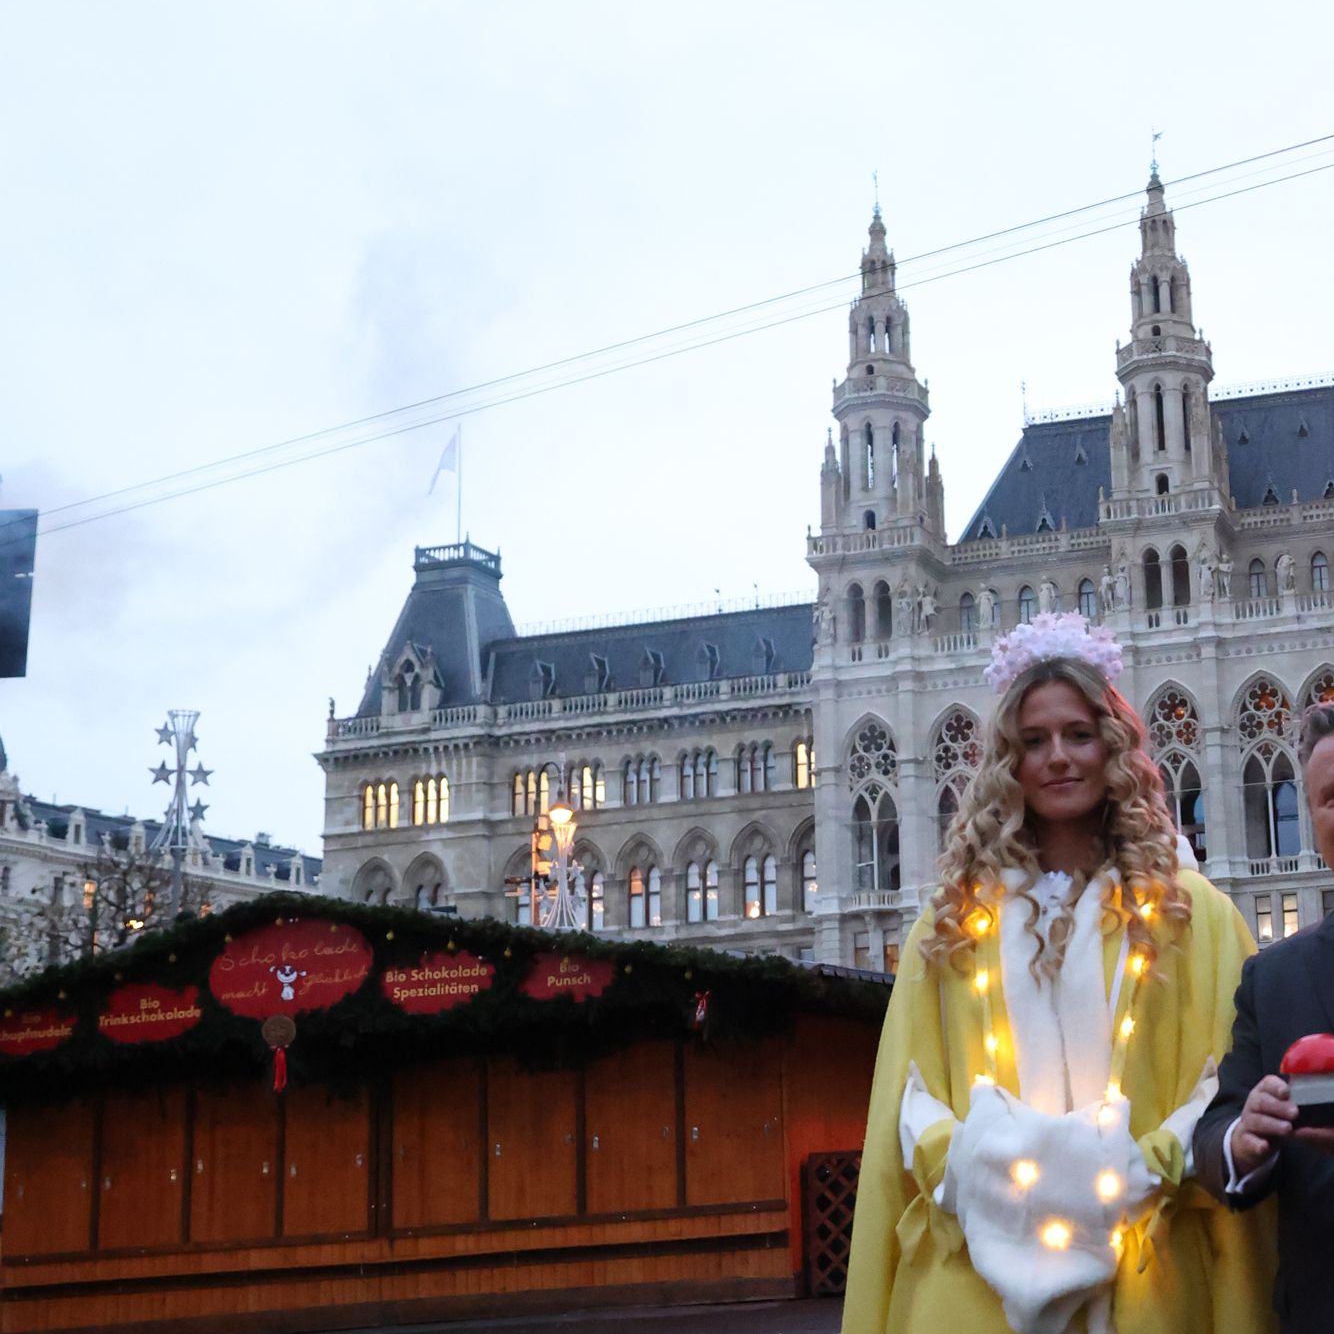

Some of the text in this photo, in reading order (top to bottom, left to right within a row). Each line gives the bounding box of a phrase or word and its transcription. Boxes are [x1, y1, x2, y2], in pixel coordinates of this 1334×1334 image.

[386, 964, 488, 983] Bio Schokolade
[559, 963, 579, 974] Bio
[547, 975, 591, 988] Punsch
[221, 982, 269, 1000] macht
[393, 983, 479, 1001] Spezialitäten
[139, 998, 161, 1010] Bio
[99, 1008, 202, 1028] Trinkschokolade
